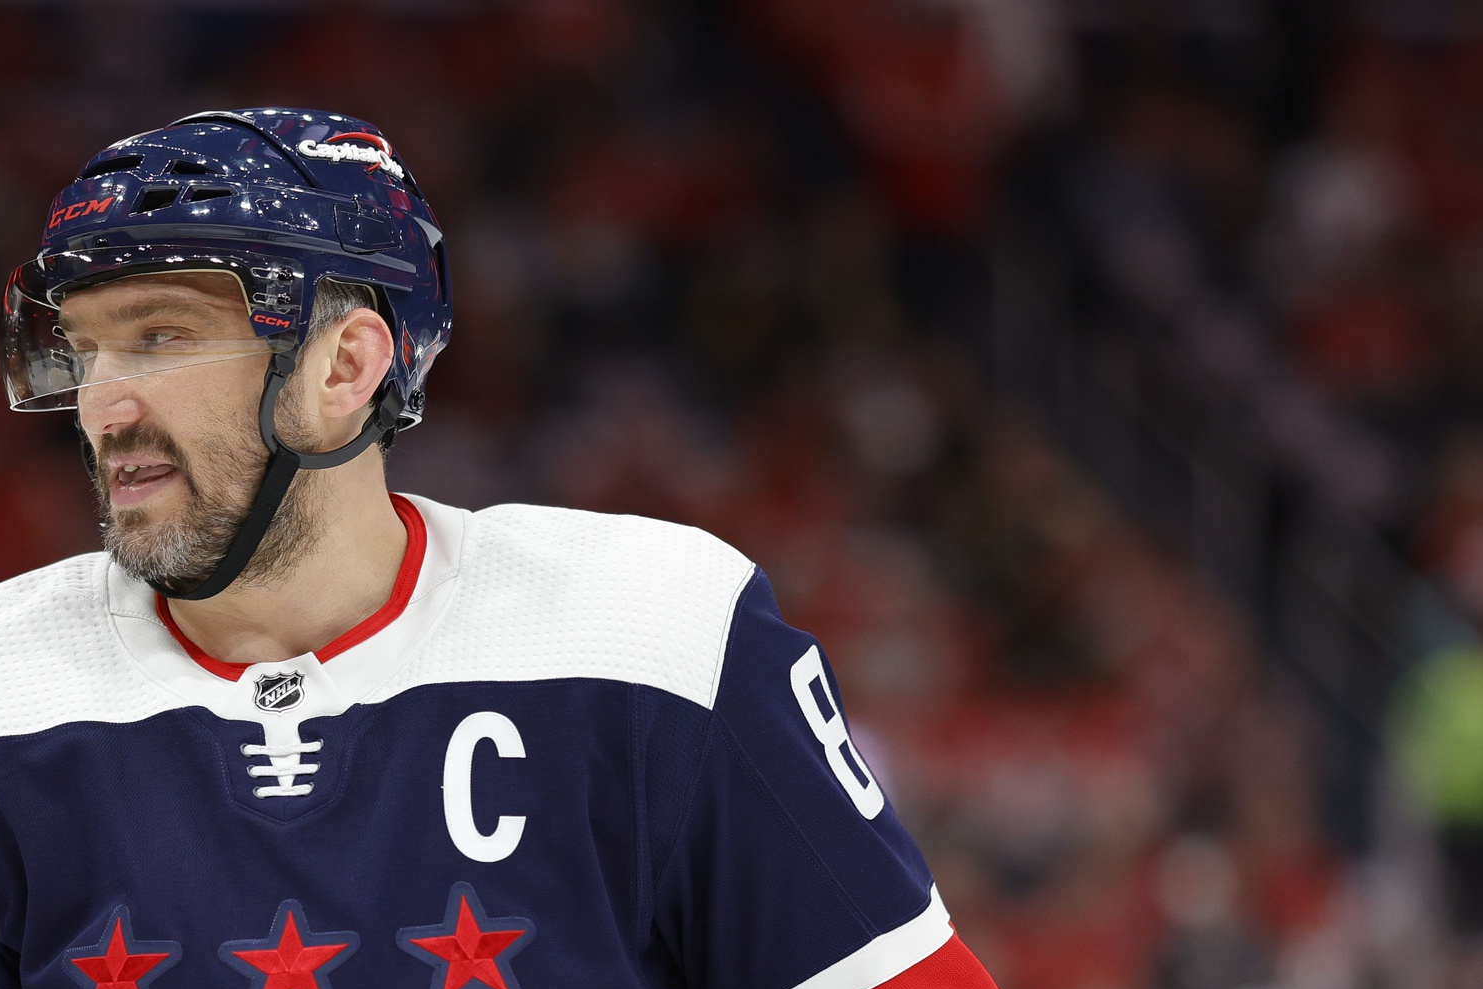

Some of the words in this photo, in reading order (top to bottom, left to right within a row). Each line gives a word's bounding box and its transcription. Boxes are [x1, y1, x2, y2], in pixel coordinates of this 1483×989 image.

[49, 196, 115, 229] CCM
[254, 314, 291, 329] CCM
[265, 680, 296, 706] NHL
[443, 711, 526, 862] C
